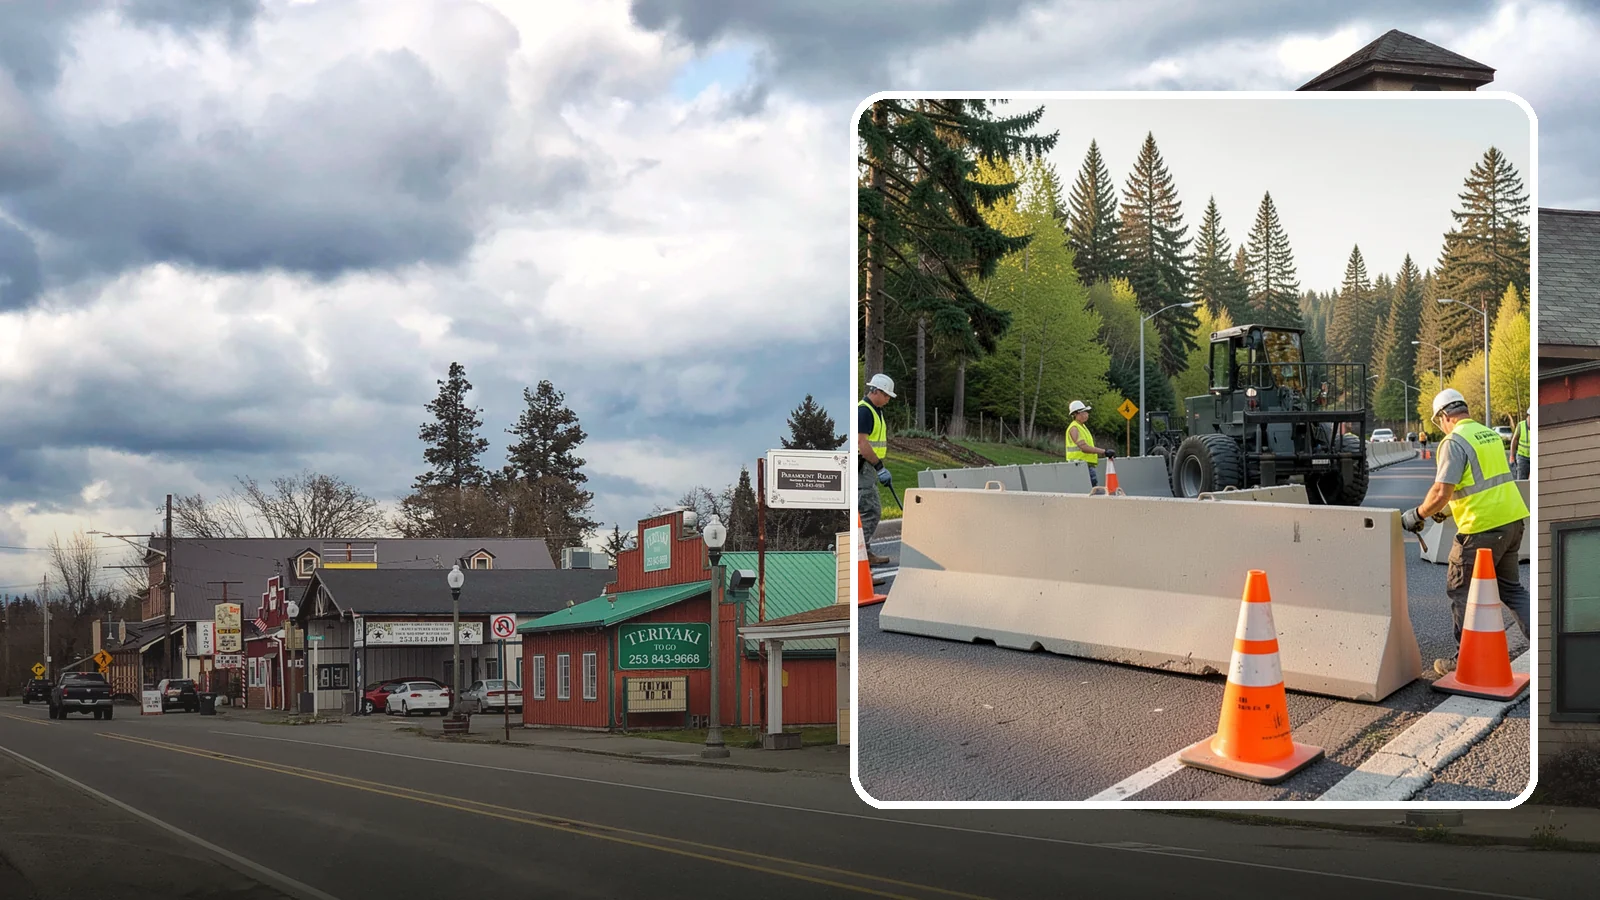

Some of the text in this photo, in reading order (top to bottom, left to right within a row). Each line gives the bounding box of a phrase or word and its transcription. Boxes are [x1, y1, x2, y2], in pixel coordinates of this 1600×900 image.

[817, 472, 839, 480] REALTY
[624, 627, 702, 646] TERIYAKI
[629, 653, 700, 664] 253 843-9668
[639, 681, 673, 690] TERIYAKI
